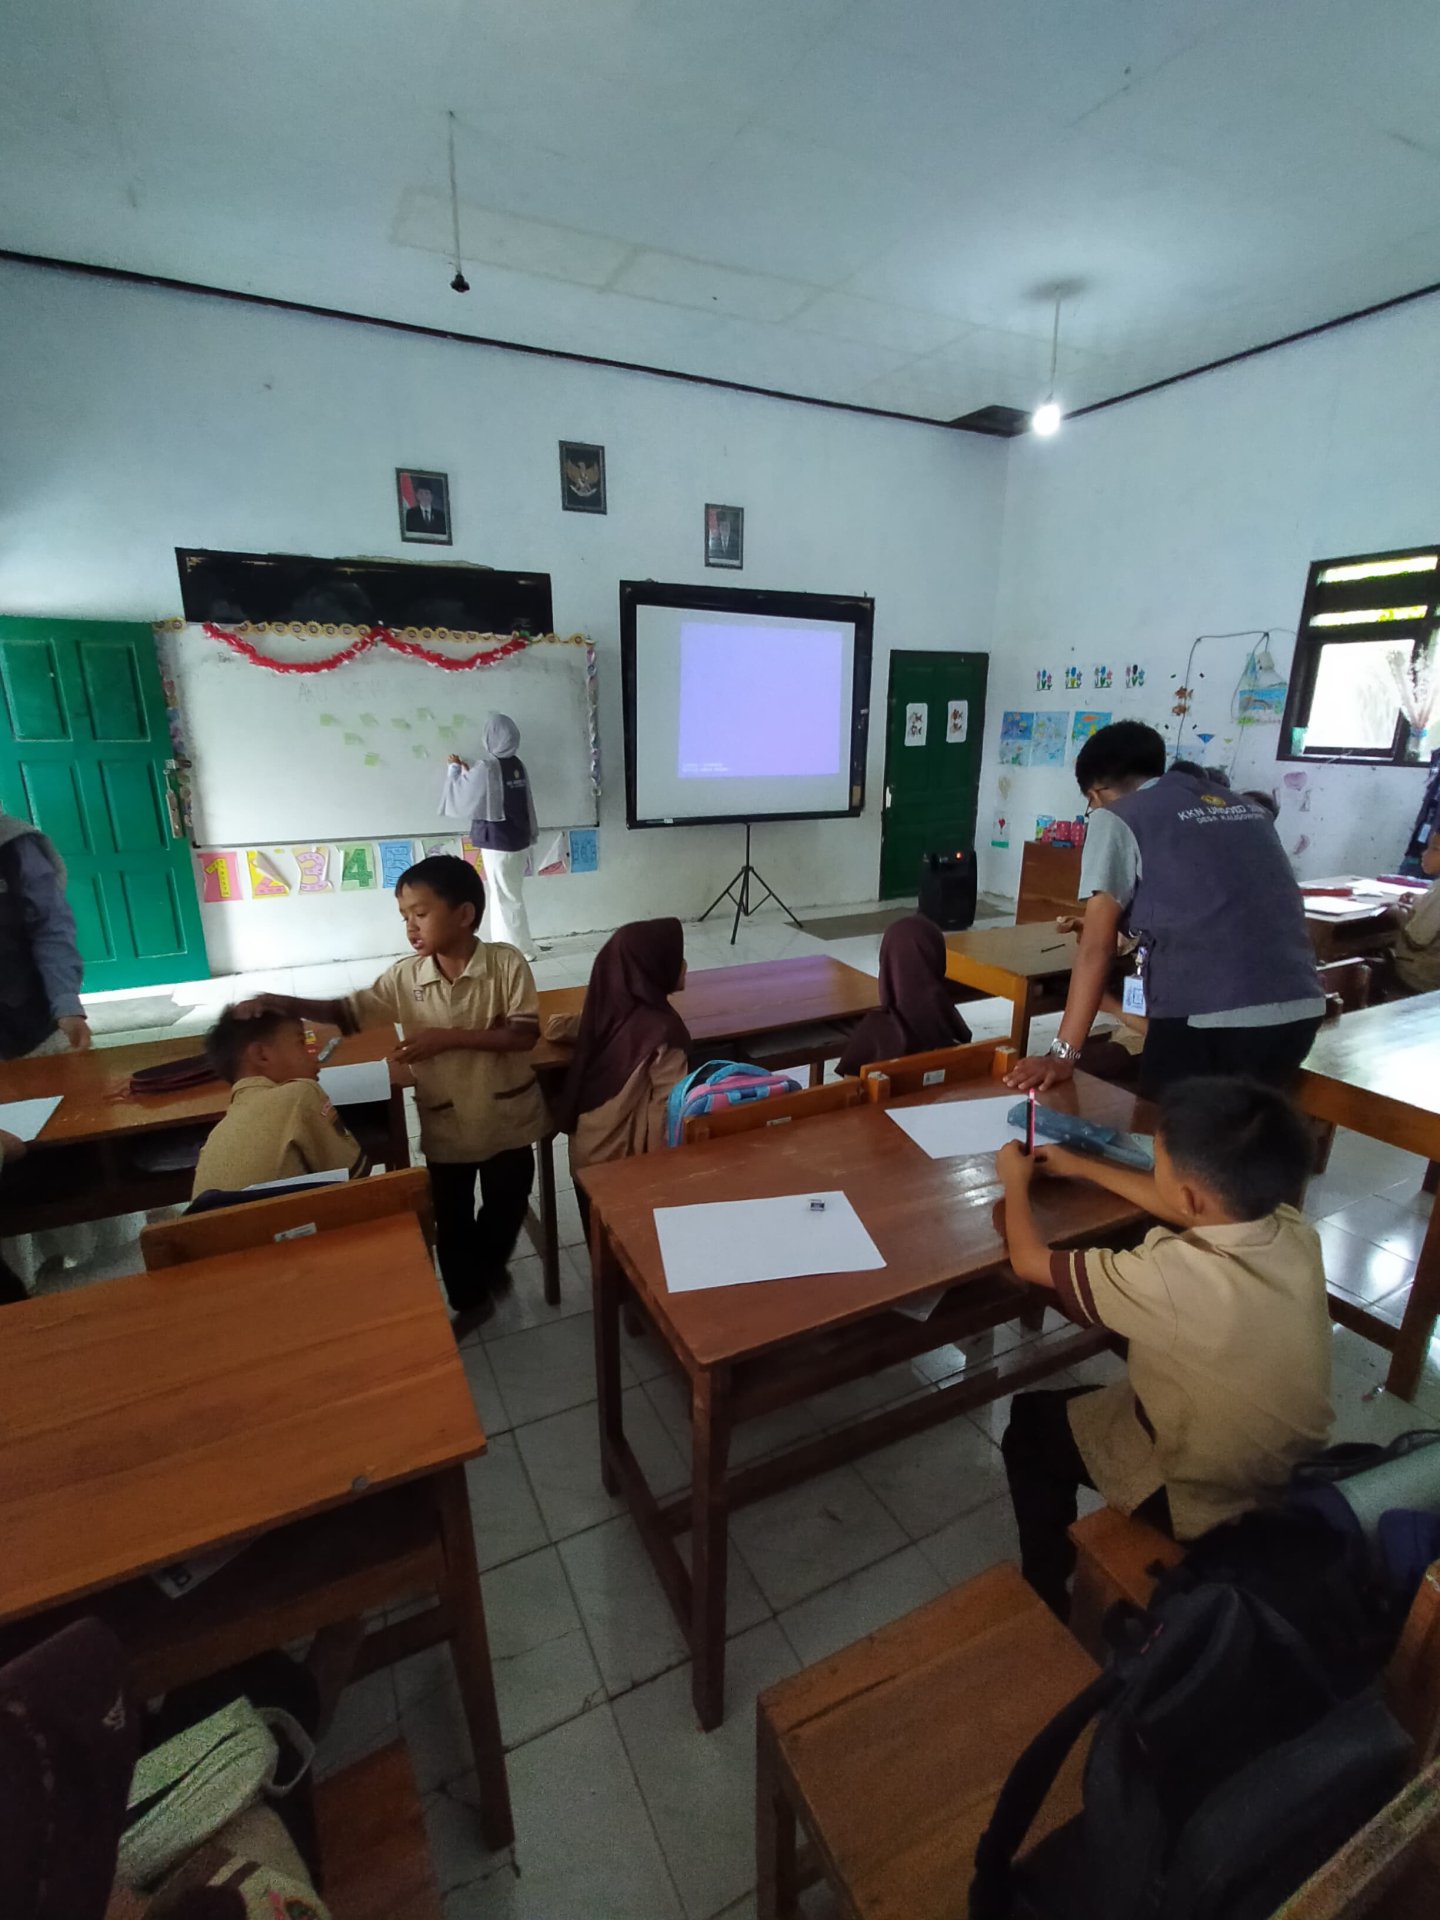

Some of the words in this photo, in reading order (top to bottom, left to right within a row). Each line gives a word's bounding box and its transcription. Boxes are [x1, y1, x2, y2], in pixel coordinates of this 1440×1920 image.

[1177, 808, 1205, 821] KKN
[204, 857, 231, 898] 1
[295, 851, 329, 892] 3
[343, 848, 373, 887] 4
